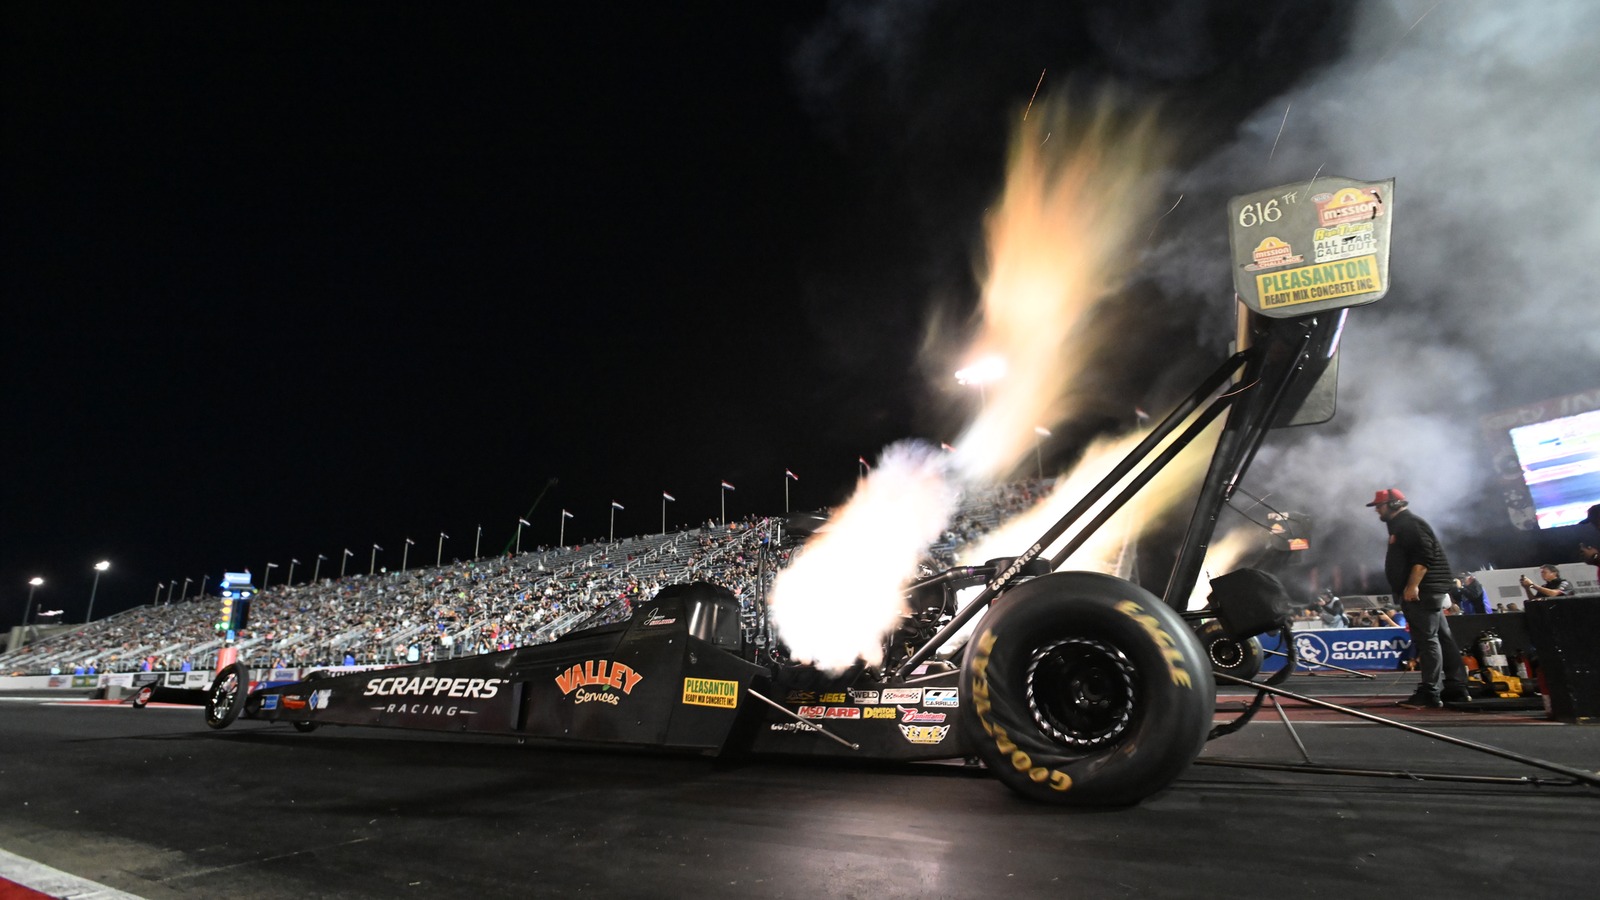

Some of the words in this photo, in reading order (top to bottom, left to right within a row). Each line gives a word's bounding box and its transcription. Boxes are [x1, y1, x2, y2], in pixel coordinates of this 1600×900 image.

[1239, 199, 1282, 227] 616
[1317, 240, 1337, 250] ALL
[1341, 233, 1371, 245] STAR
[1317, 241, 1372, 257] CALLOUT
[1262, 258, 1371, 293] PLEASANTON
[1265, 290, 1291, 305] READY
[1293, 288, 1310, 301] MIX
[1311, 281, 1355, 297] CONCRETE
[1357, 277, 1375, 291] INC.
[992, 543, 1041, 591] GOODYEAR
[1331, 650, 1403, 660] QUALITY
[555, 660, 643, 695] VALLEY
[686, 680, 735, 696] PLEASANTON
[575, 688, 620, 706] Services
[685, 693, 697, 702] READY
[706, 695, 726, 706] CONCRETE
[819, 693, 846, 702] JEGS
[386, 703, 458, 717] RACING
[800, 706, 824, 715] MSD
[825, 708, 859, 717] ARP
